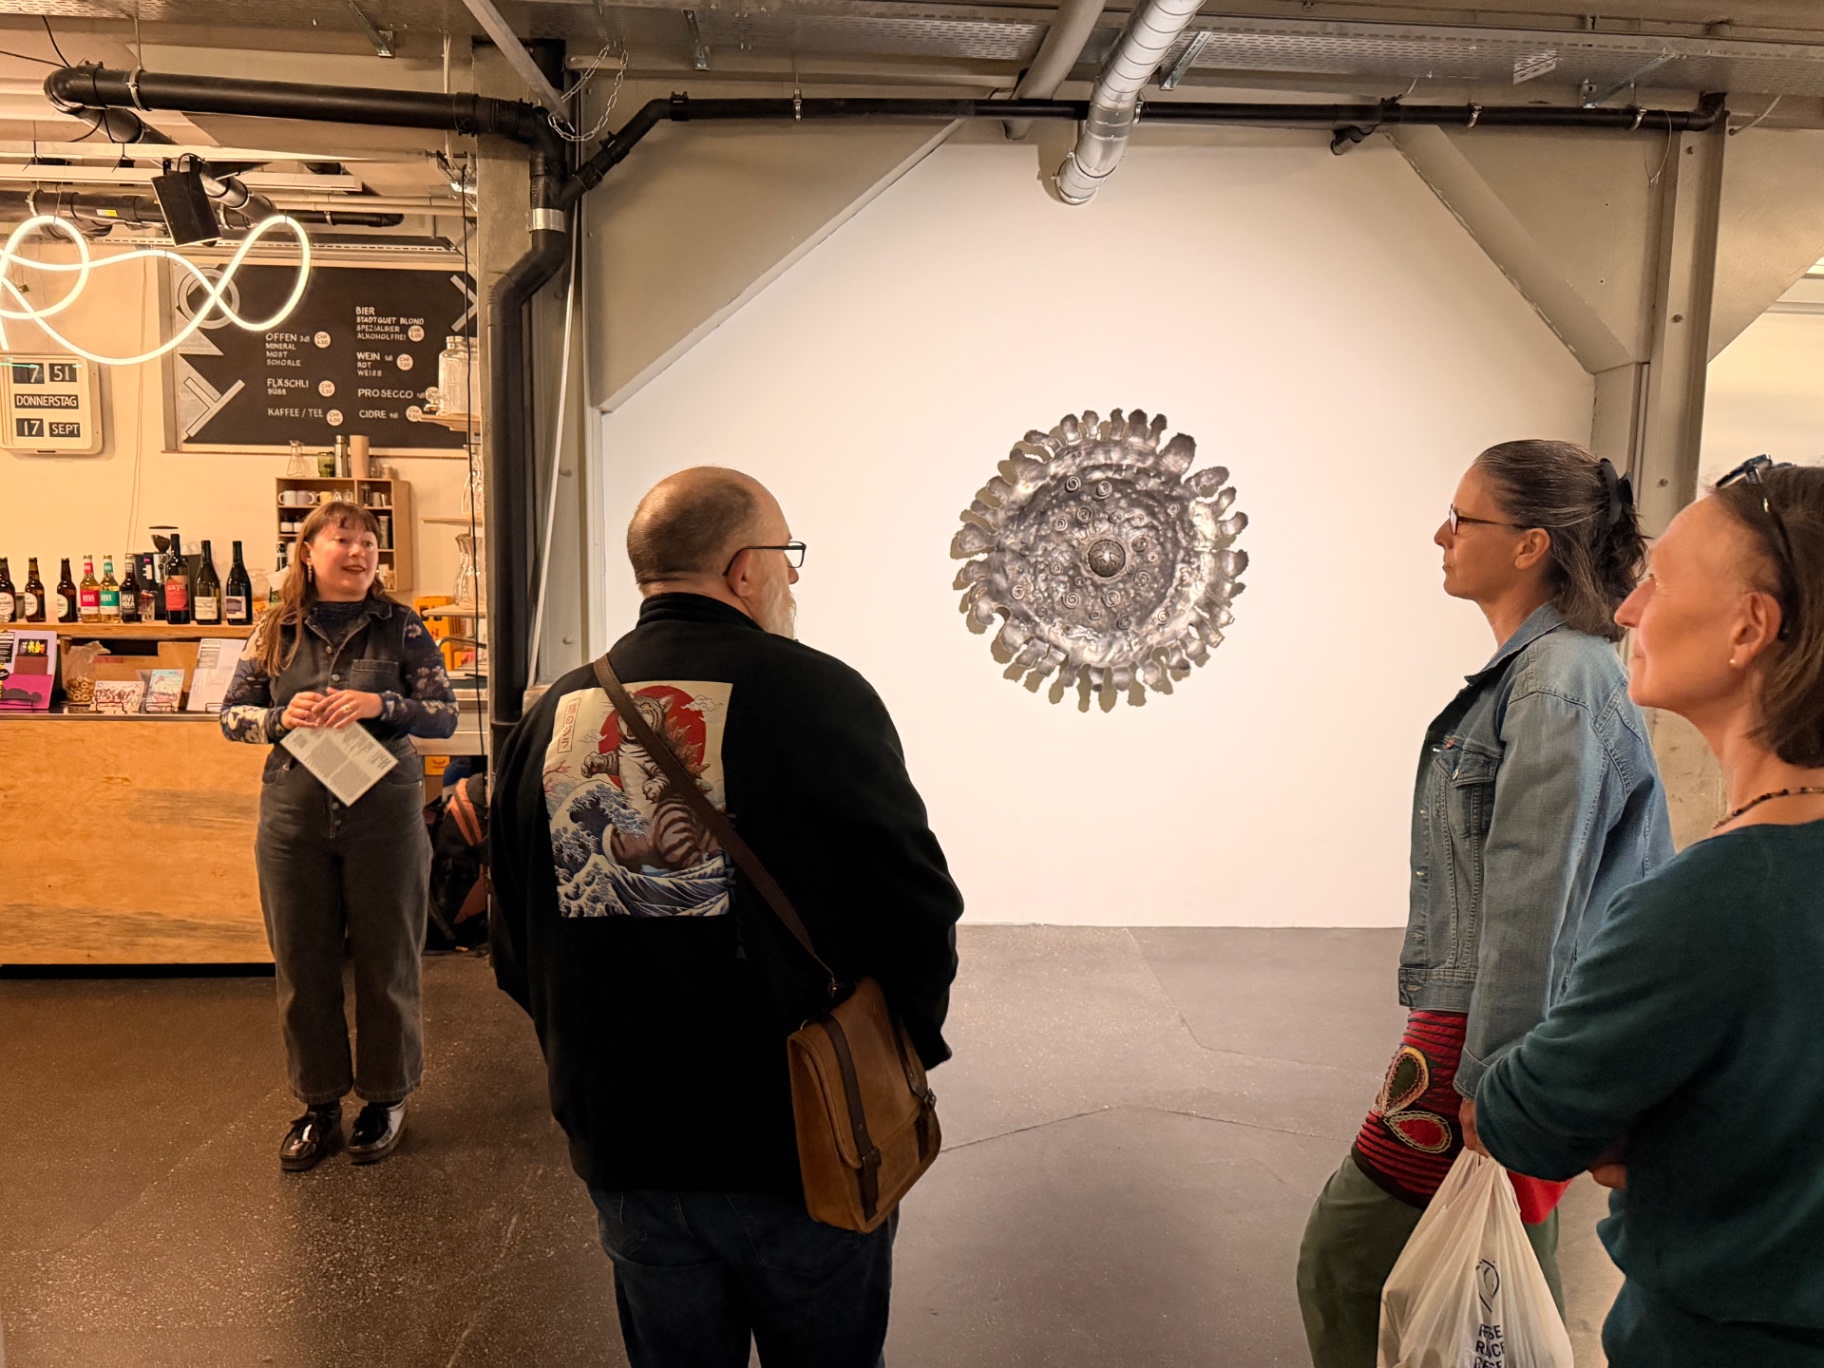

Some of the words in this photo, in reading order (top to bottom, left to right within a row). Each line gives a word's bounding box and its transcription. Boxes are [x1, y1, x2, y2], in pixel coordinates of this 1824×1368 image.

[355, 306, 375, 315] BIER
[400, 317, 424, 325] BLOND
[356, 324, 400, 332] SPEZIALBIER
[265, 332, 297, 342] OFFEN
[356, 352, 380, 360] WEIN
[267, 359, 301, 367] SCHORLE
[53, 365, 70, 381] 51
[357, 369, 382, 377] WEISS
[267, 377, 309, 388] FLÄSCHLI
[357, 388, 413, 399] PROSECCO
[16, 395, 77, 407] DONNERSTAG
[267, 408, 299, 417] KAFFEE
[308, 408, 323, 417] TEE
[358, 409, 386, 418] CIDRE
[24, 420, 40, 436] 17
[51, 424, 79, 435] SEPT
